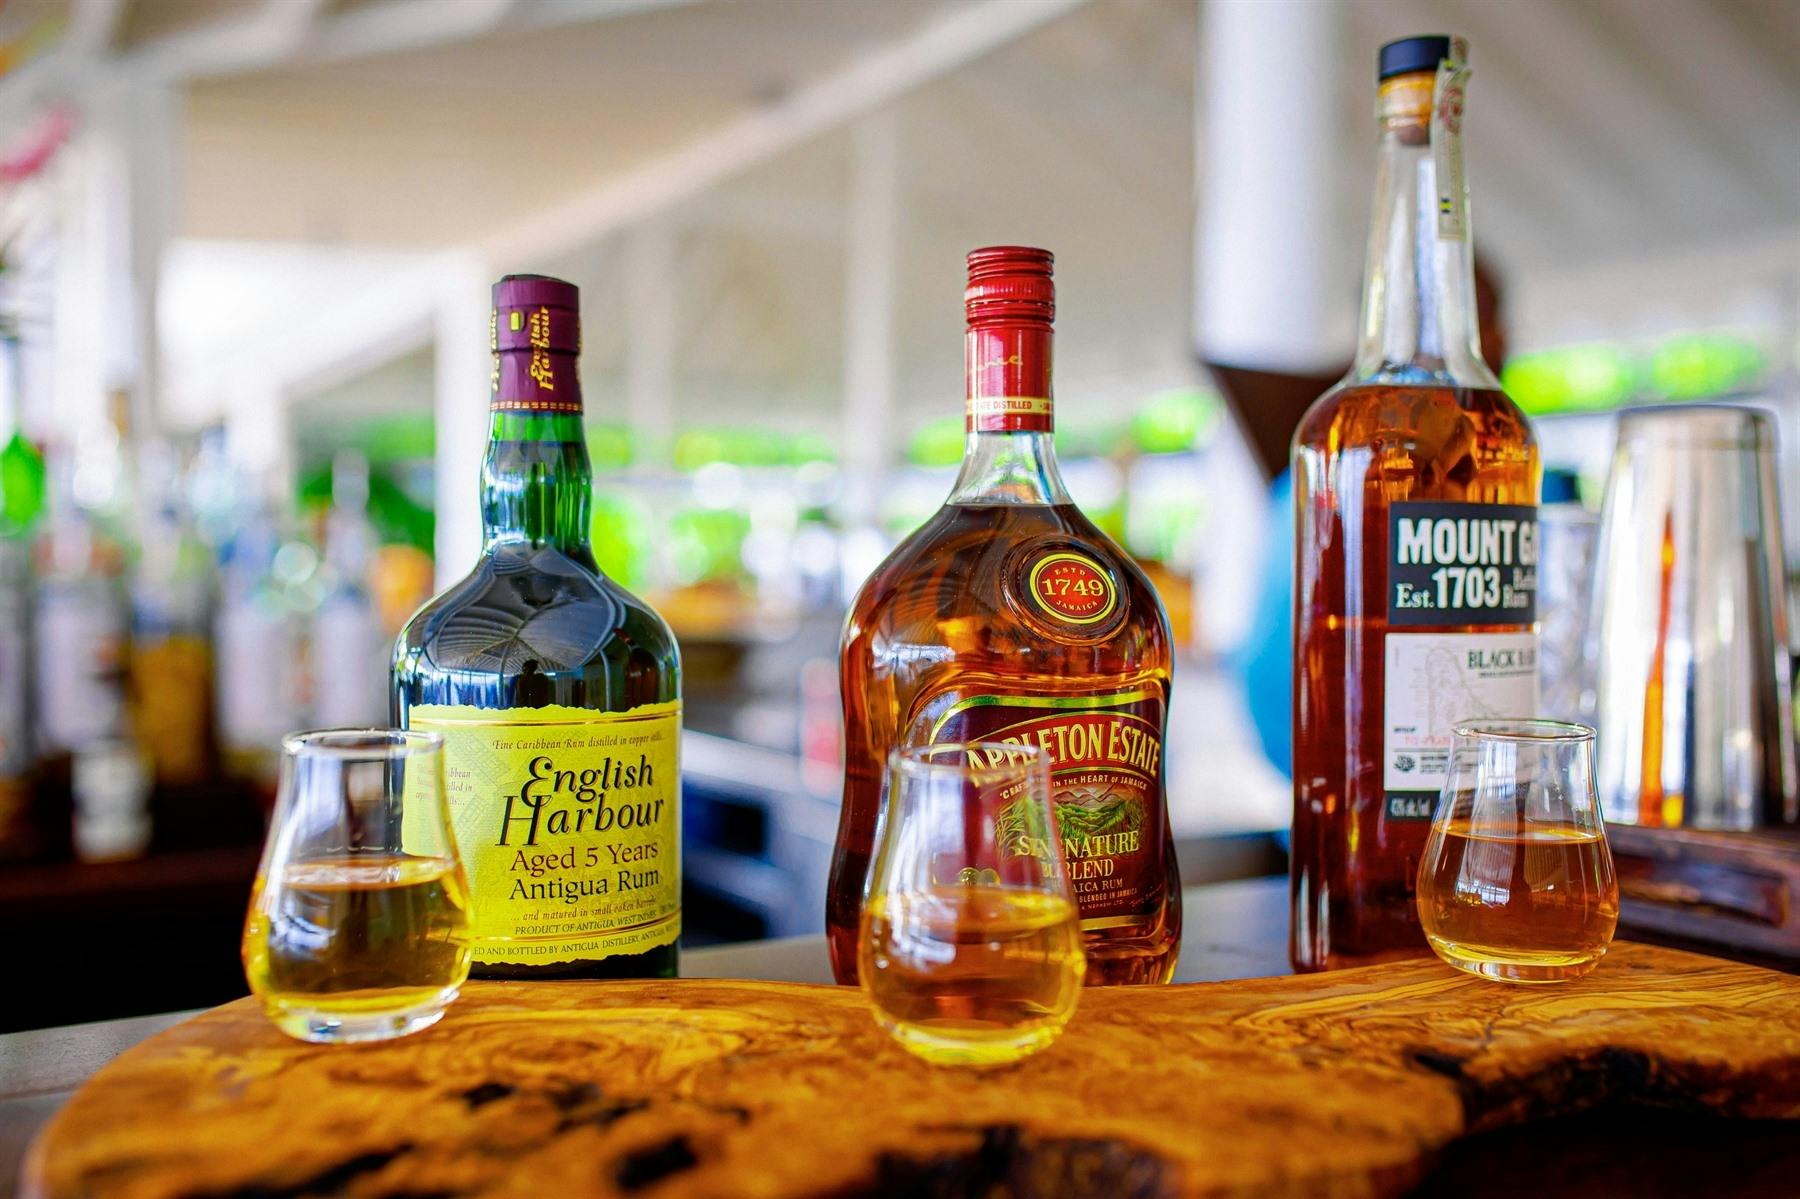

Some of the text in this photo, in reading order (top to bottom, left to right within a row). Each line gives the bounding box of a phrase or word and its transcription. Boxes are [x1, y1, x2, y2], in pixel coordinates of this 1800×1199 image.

[994, 401, 1032, 410] DISTILLED
[1397, 518, 1517, 566] MOUNT
[1042, 579, 1104, 597] 1749
[1396, 583, 1435, 608] Est.
[1431, 566, 1501, 608] 1703
[1056, 600, 1098, 611] JAMAICA
[1468, 648, 1516, 669] BLACK
[492, 739, 513, 750] Fine
[516, 738, 561, 750] Caribbean
[564, 739, 585, 748] Rum
[588, 735, 618, 747] distilled
[620, 736, 627, 744] in
[1107, 721, 1160, 776] ESTATE
[520, 754, 654, 809] English
[1064, 778, 1078, 786] THE
[1081, 775, 1109, 783] HEART
[1120, 777, 1148, 790] JAMAICA
[495, 794, 664, 847] Harbour
[510, 841, 658, 878] Aged 5 Years
[509, 877, 608, 904] Antigua
[618, 870, 659, 893] Rum
[1102, 879, 1123, 891] RUM
[523, 910, 539, 921] and
[543, 907, 577, 920] matured
[580, 905, 588, 917] in
[515, 925, 561, 935] PRODUCT
[562, 923, 576, 933] OF
[576, 920, 615, 931] ANTIGUA
[617, 915, 637, 926] WEST
[487, 947, 506, 956] AND
[507, 946, 547, 955] BOTTLED
[548, 945, 559, 954] BY
[561, 942, 599, 953] ANTIGUA
